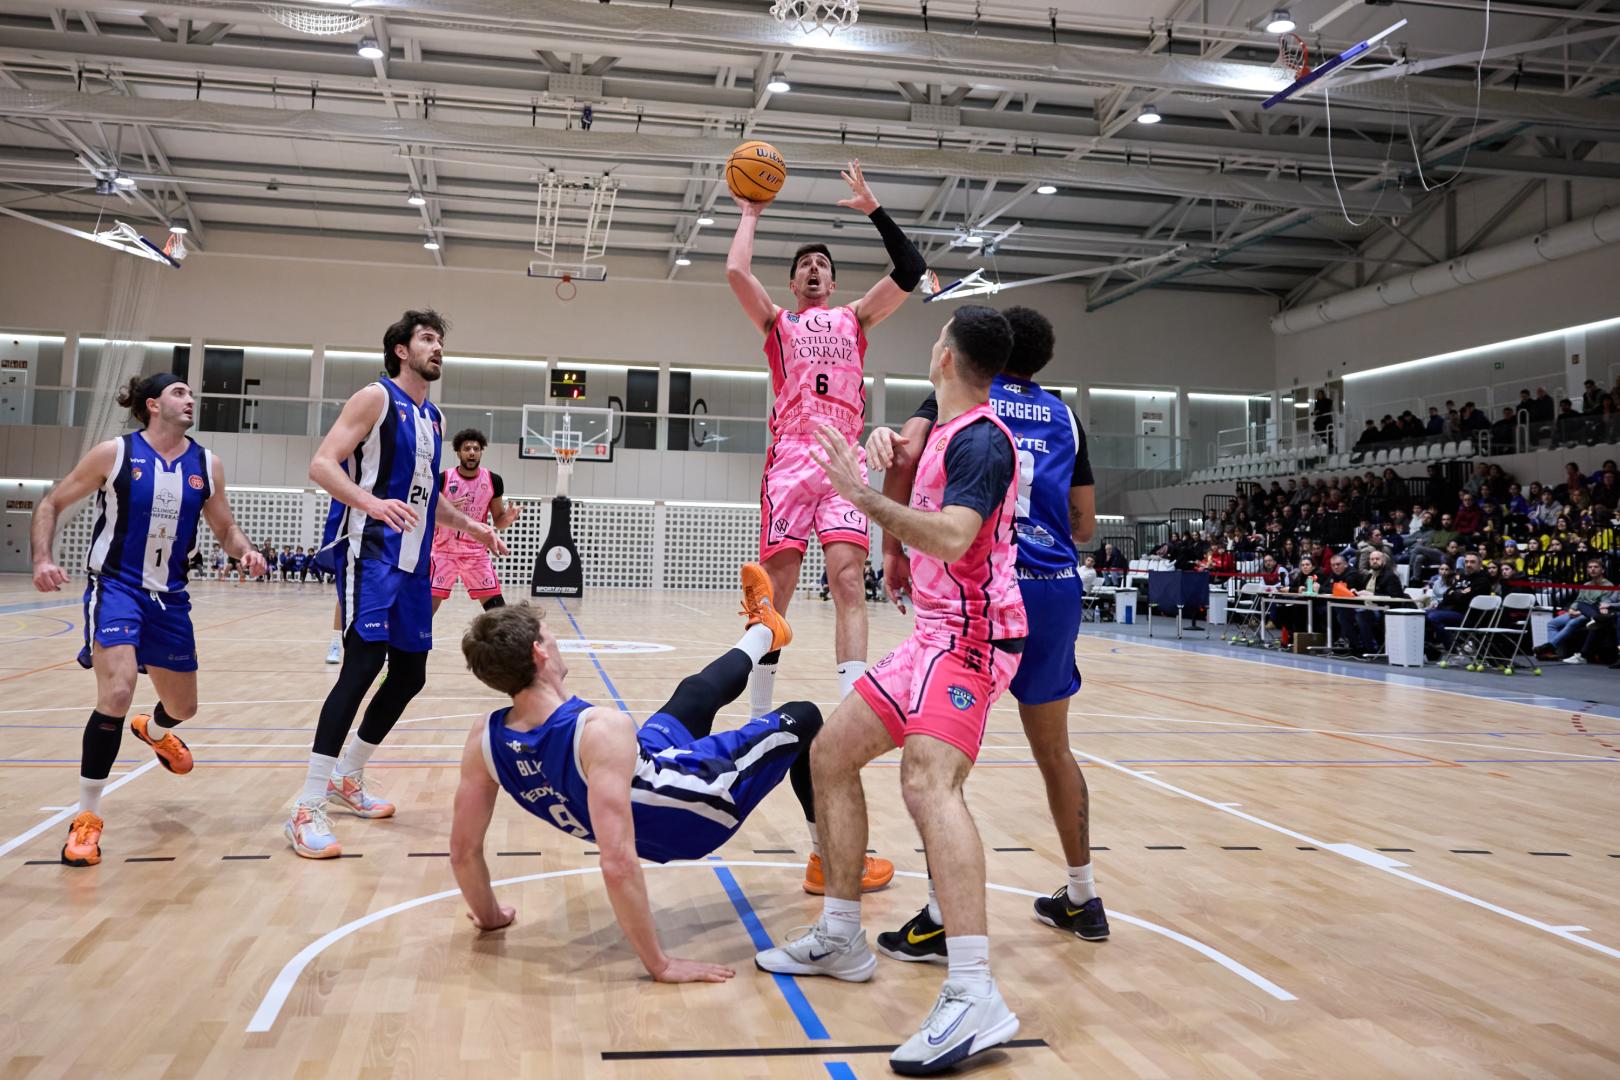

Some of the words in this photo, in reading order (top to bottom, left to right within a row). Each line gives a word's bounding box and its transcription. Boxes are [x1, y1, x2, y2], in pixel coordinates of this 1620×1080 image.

[791, 336, 838, 348] CASTILLO
[841, 337, 853, 348] DE
[793, 346, 853, 362] GORRAIZ
[815, 373, 829, 395] 6
[989, 398, 1051, 422] BERGENS
[1014, 436, 1050, 454] YTEL
[409, 484, 429, 507] 24
[155, 547, 163, 568] 1
